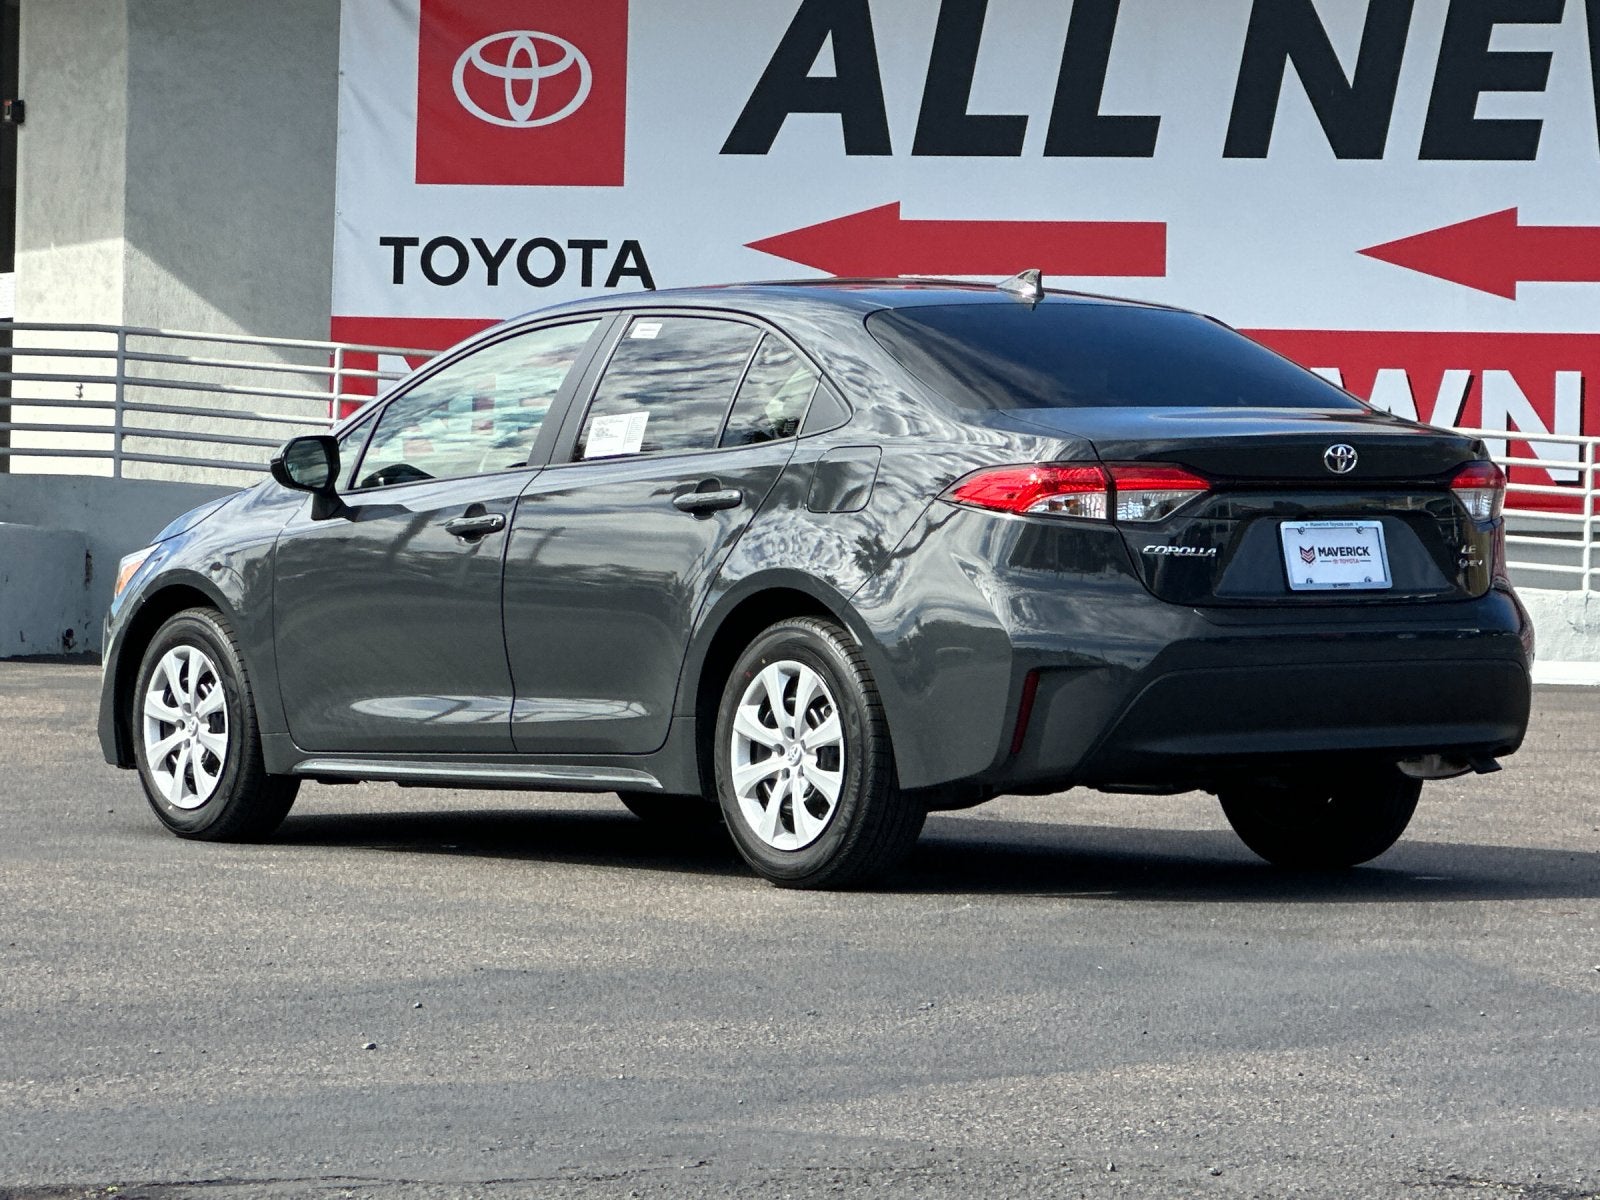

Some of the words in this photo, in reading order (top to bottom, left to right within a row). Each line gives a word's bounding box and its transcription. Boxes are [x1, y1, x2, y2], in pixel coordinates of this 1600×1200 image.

[719, 0, 1161, 158] ALL
[1222, 0, 1600, 161] NE
[379, 235, 656, 291] TOYOTA
[1142, 545, 1217, 557] COROLLA
[1318, 546, 1371, 557] MAVERICK
[1461, 545, 1476, 554] LE
